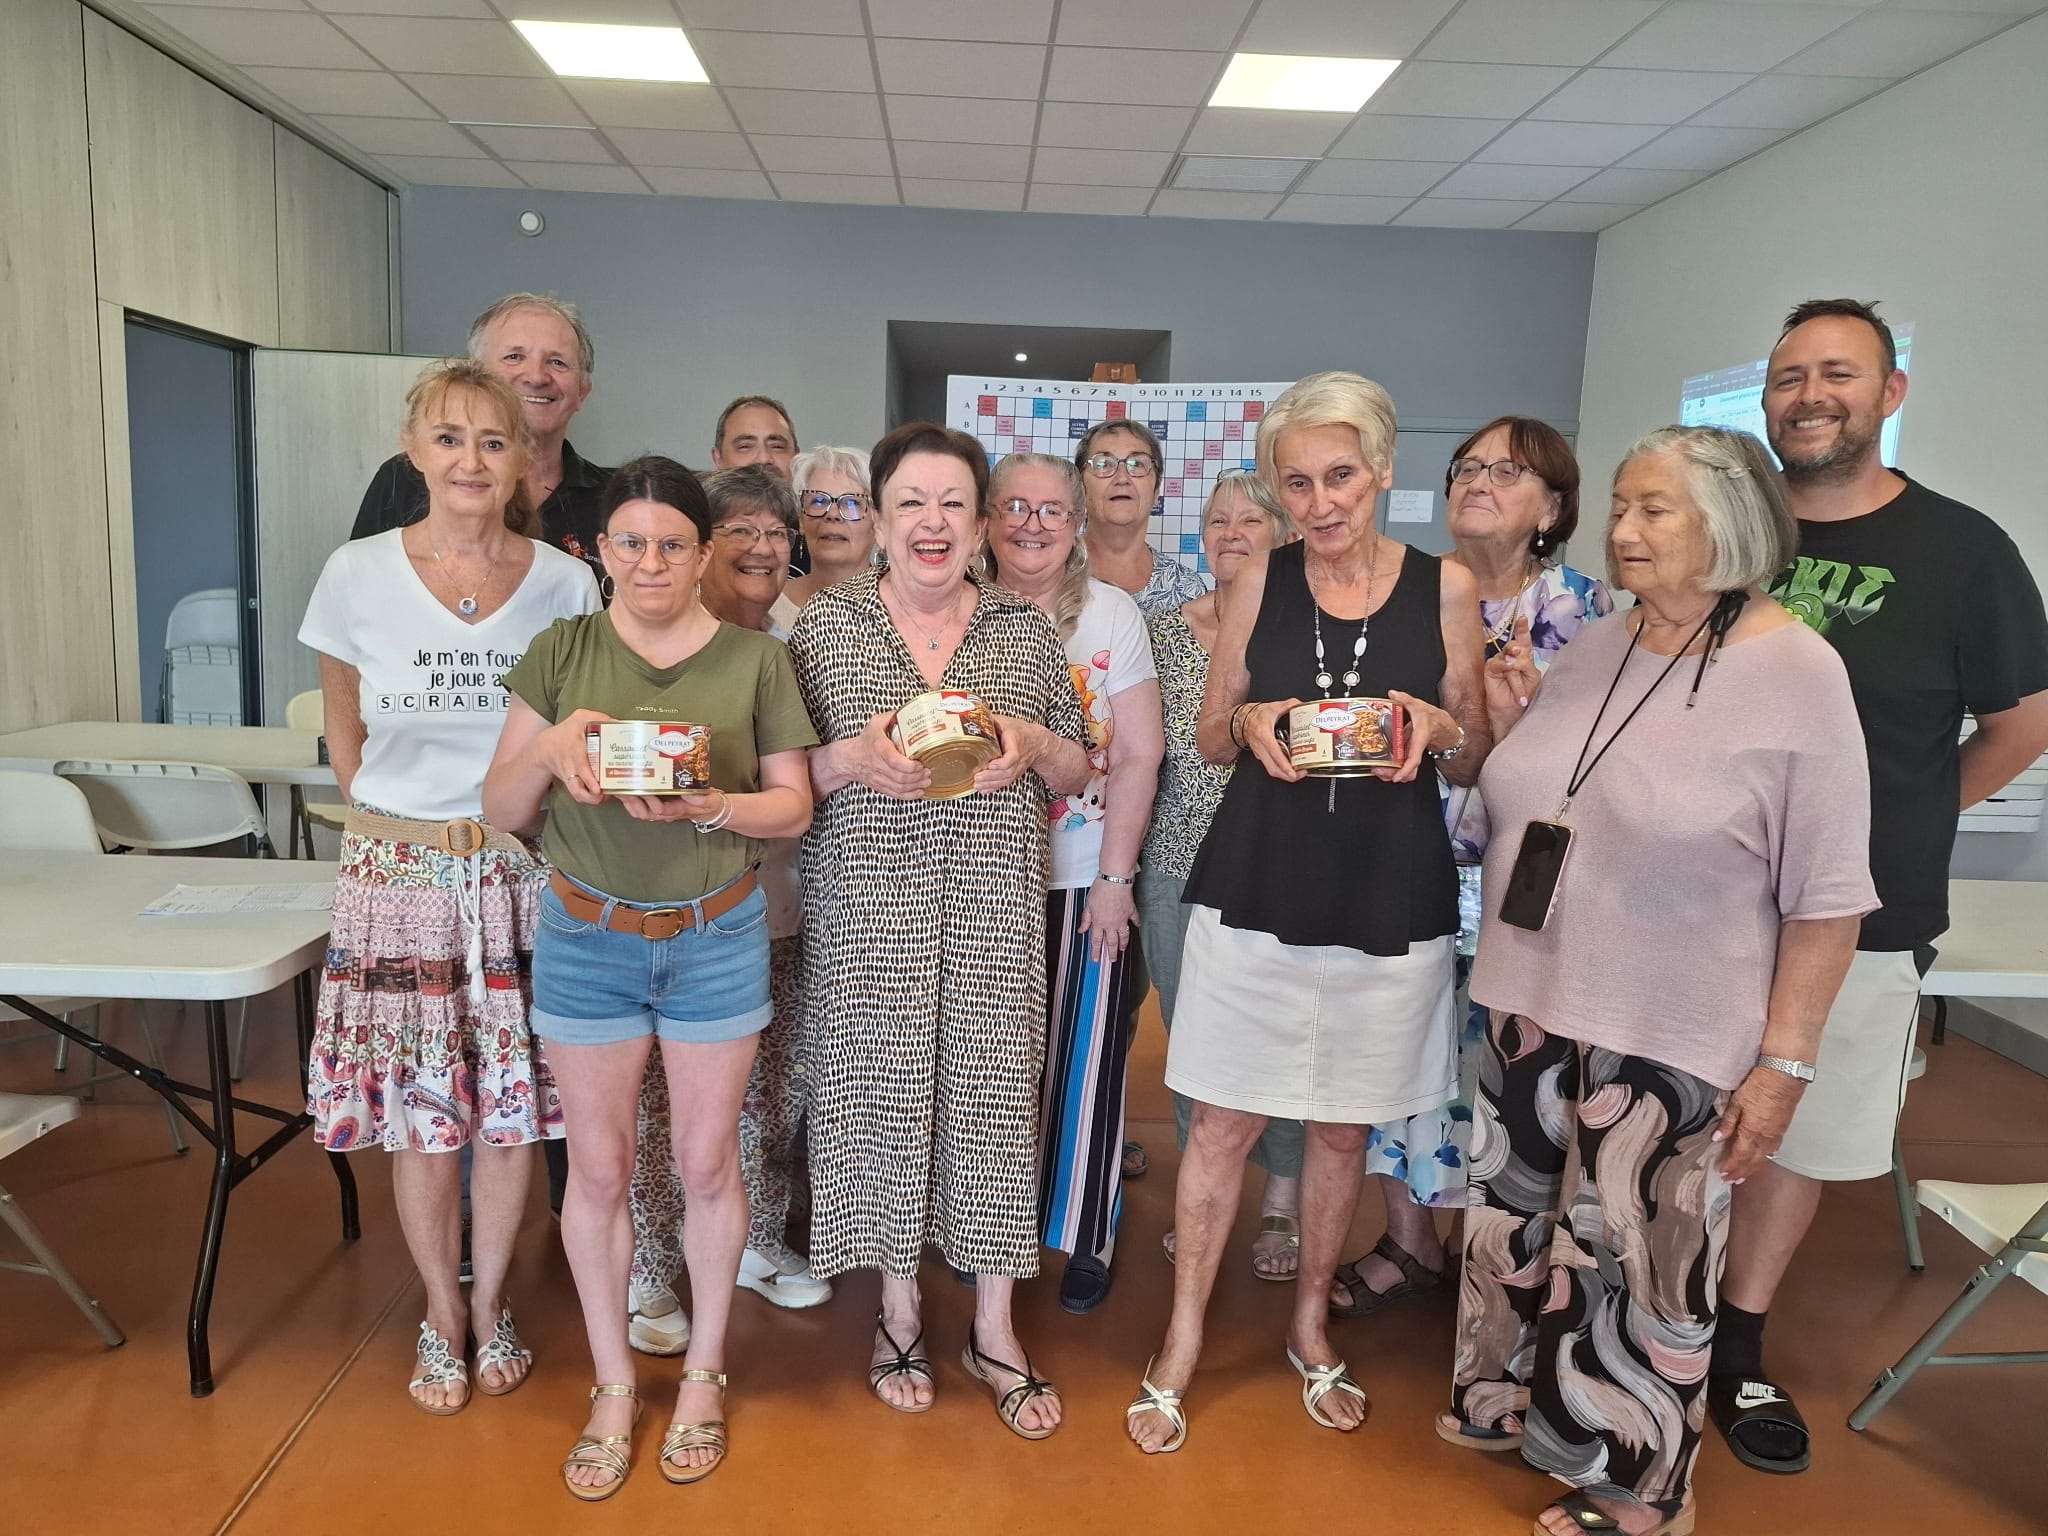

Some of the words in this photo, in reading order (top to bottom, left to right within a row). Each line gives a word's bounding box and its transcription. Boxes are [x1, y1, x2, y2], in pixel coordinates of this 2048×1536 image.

[984, 383, 989, 391] 1
[413, 649, 432, 667] Je
[437, 649, 479, 667] m'en
[426, 669, 445, 690] je
[447, 669, 486, 690] joue
[1741, 1381, 1777, 1400] NIKE
